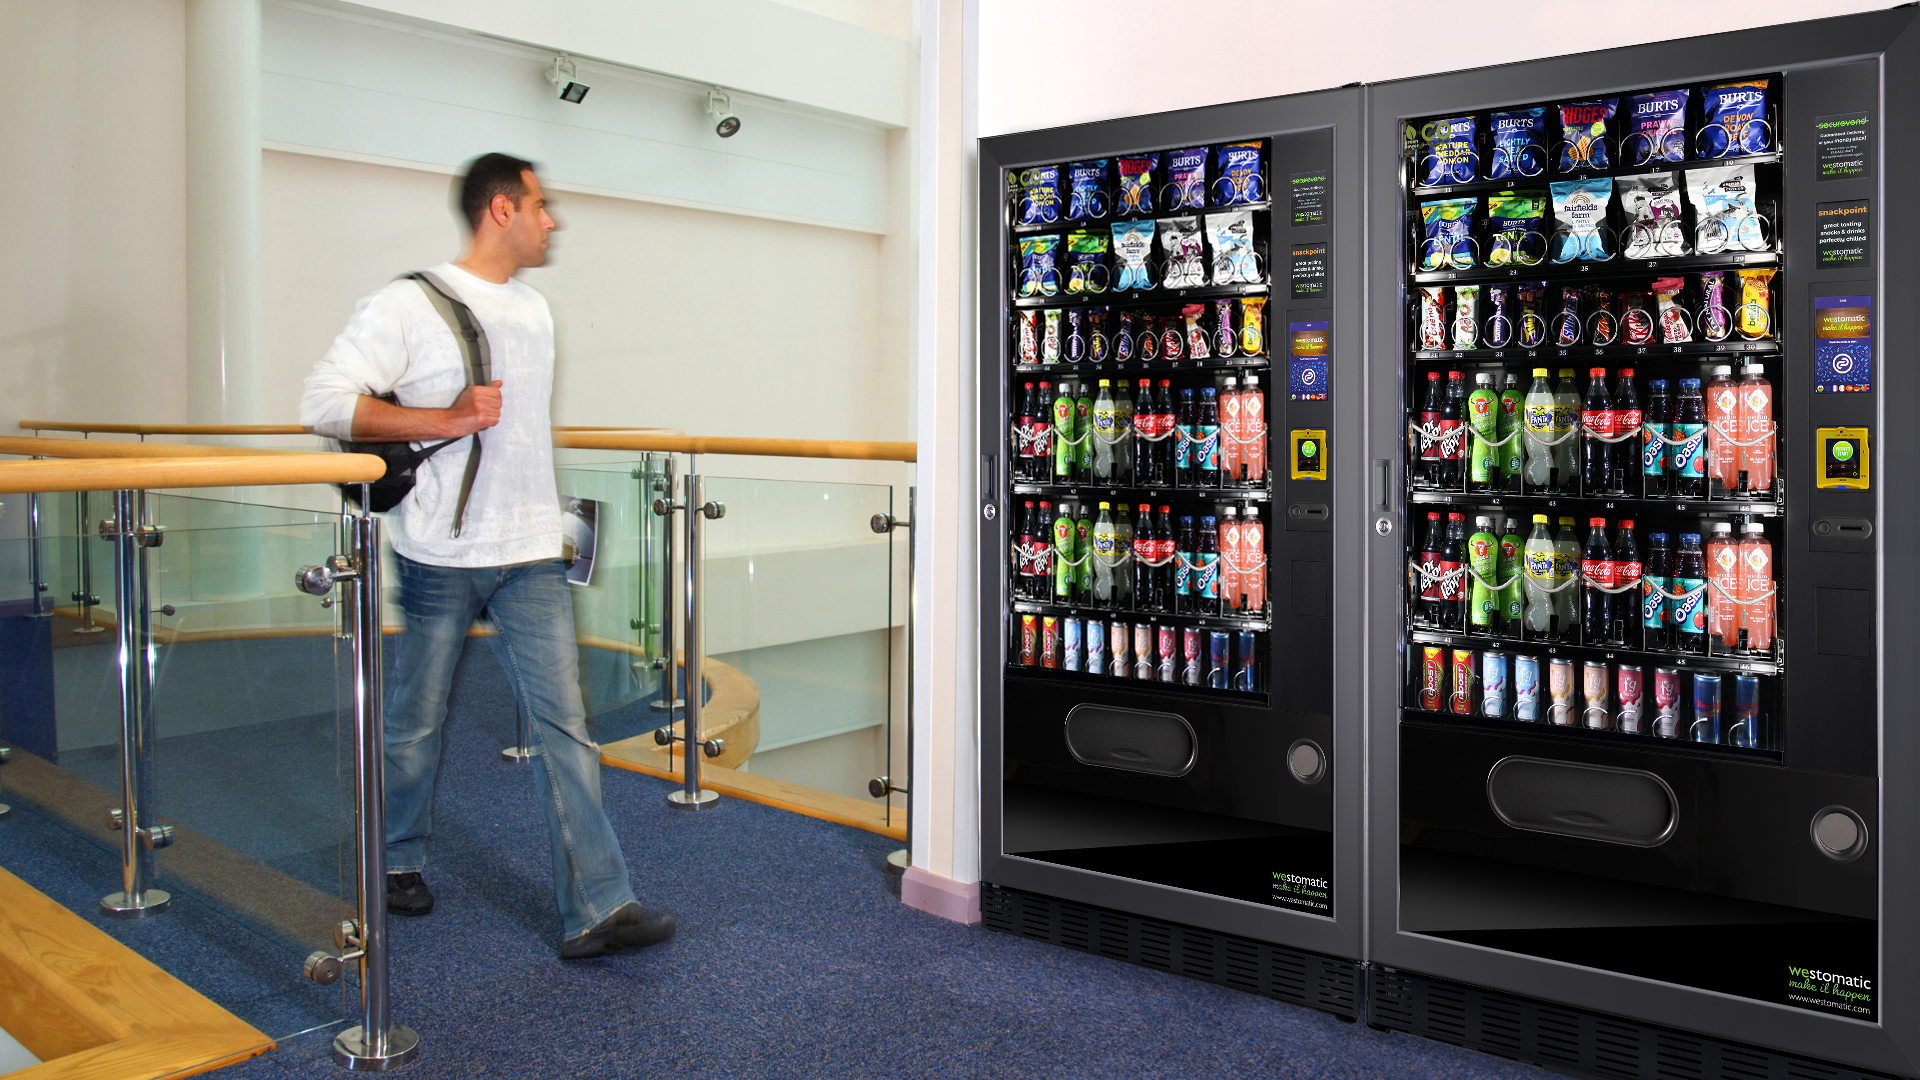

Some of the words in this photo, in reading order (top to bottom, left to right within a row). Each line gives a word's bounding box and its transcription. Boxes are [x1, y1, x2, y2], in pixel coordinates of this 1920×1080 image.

[1719, 92, 1763, 105] BURTS
[1638, 99, 1679, 114] BURTS
[1562, 107, 1607, 125] RIDGES
[1723, 113, 1754, 123] DEVON
[1498, 118, 1534, 129] BURTS
[1641, 119, 1674, 129] PRAWN
[1818, 116, 1868, 130] securevend
[1500, 138, 1531, 147] LIGHTLY
[1172, 155, 1201, 168] BURTS
[1228, 150, 1258, 162] BURTS
[1119, 160, 1151, 175] RIDGES
[1822, 159, 1864, 170] westomatic
[1074, 168, 1101, 179] BURTS
[1564, 203, 1598, 213] fairfields
[1818, 206, 1867, 217] snackpoint
[1823, 222, 1839, 230] great
[1840, 220, 1862, 229] tasting
[1819, 236, 1845, 245] perfectly
[1846, 235, 1867, 243] chilled
[1292, 247, 1326, 256] snackpoint
[1822, 247, 1863, 257] westomatic
[1704, 279, 1715, 315] NATURAL
[1707, 316, 1718, 330] EAT
[1823, 314, 1866, 323] westomatic
[1747, 420, 1769, 433] ICE
[1511, 459, 1520, 468] 95
[1747, 578, 1769, 592] ICE
[1511, 604, 1520, 612] 95
[1427, 663, 1435, 696] BOOST
[1271, 871, 1328, 889] westomatic
[1788, 965, 1871, 990] westomatic
[1788, 978, 1818, 992] make
[1819, 982, 1830, 994] it
[1832, 983, 1871, 1002] happen
[1788, 993, 1871, 1015] www.westomatic.com
